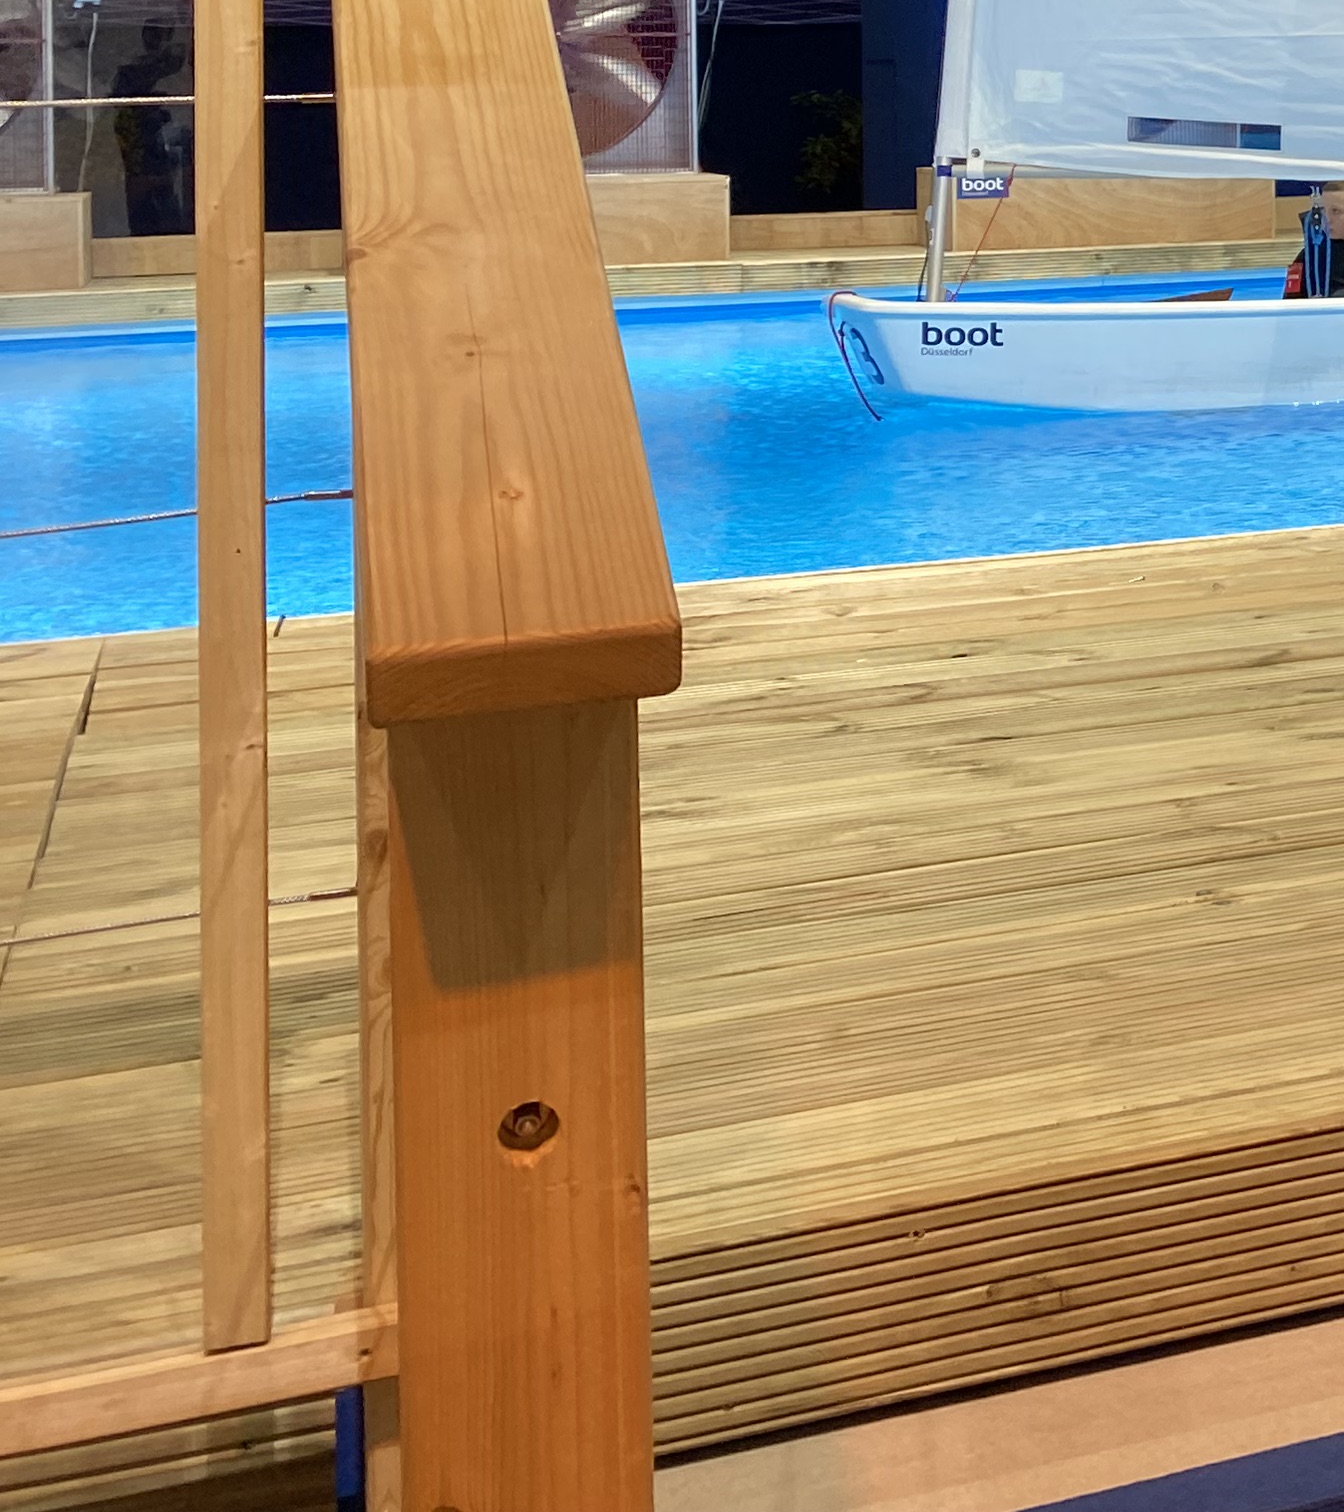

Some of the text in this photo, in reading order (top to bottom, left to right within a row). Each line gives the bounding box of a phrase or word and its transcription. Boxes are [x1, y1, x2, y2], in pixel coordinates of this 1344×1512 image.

[961, 177, 1004, 191] boot
[921, 321, 1004, 347] boot
[920, 346, 974, 357] Düsseldorf
